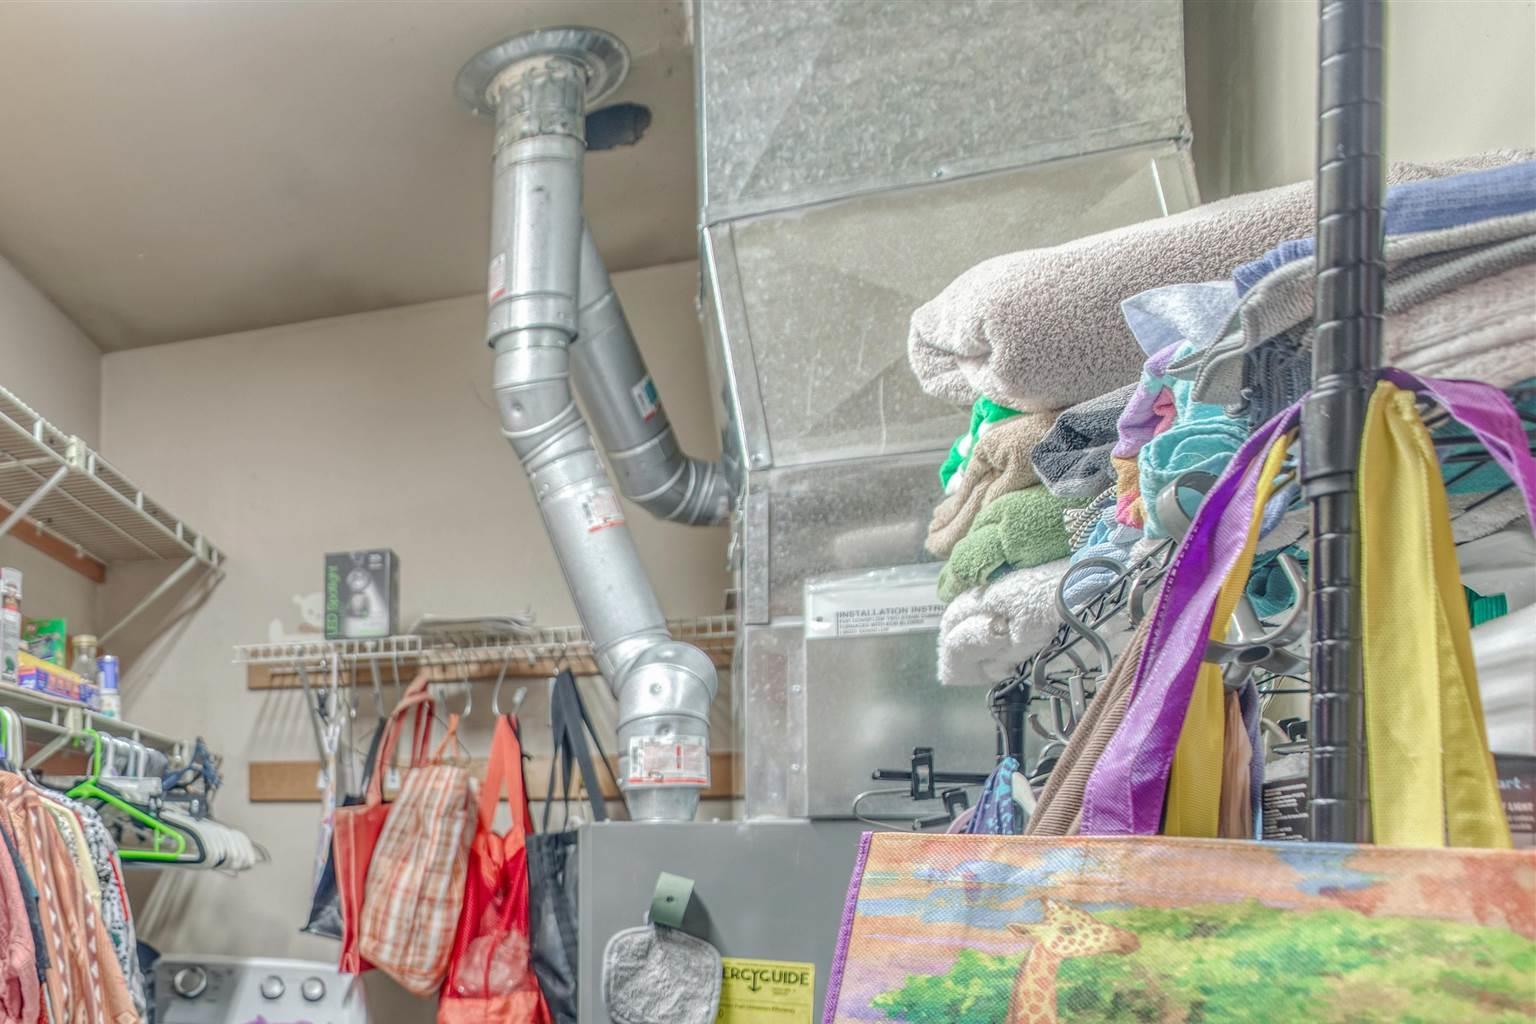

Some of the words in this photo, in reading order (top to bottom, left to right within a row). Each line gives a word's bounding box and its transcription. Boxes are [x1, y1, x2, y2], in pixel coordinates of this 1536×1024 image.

[327, 565, 342, 610] Spotlight
[838, 606, 909, 618] INSTALLATION
[327, 613, 338, 635] LED
[722, 966, 810, 987] ERGYGUIDE
